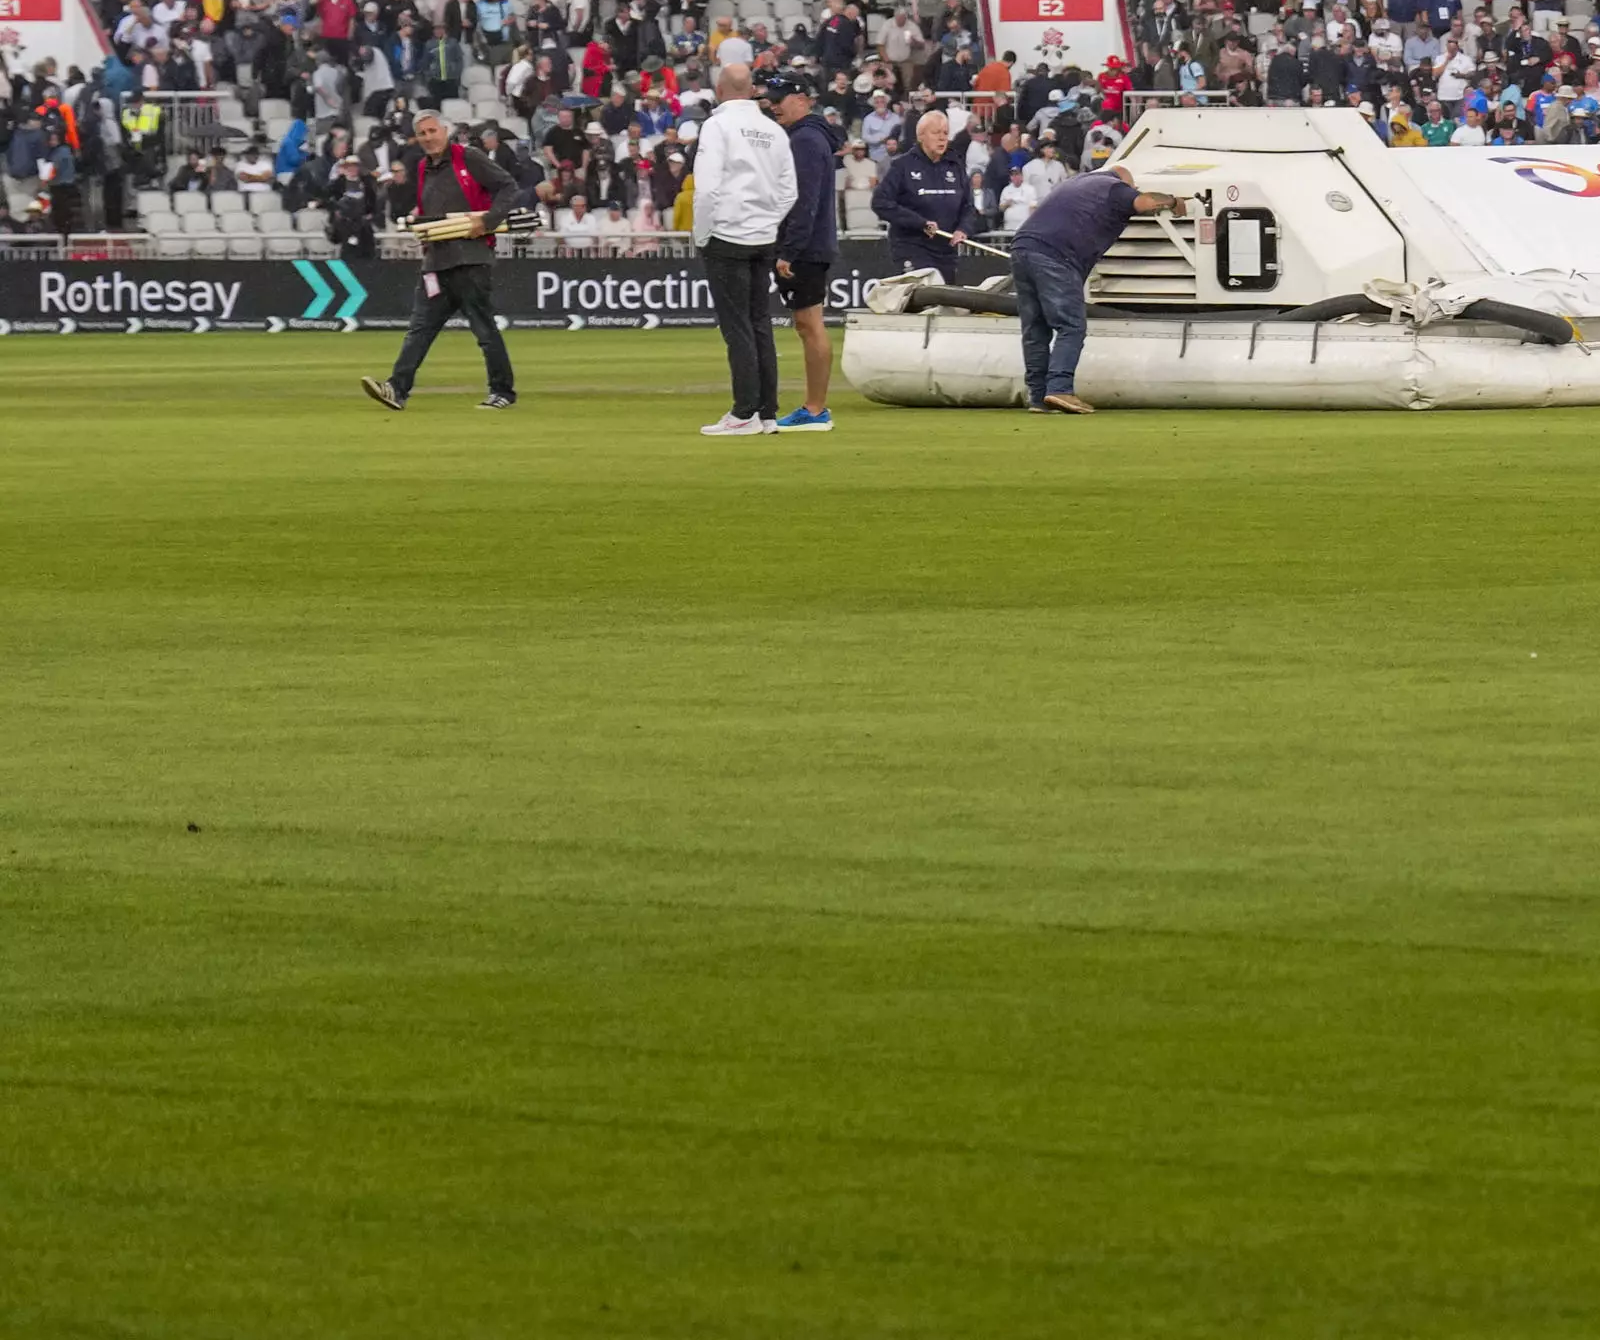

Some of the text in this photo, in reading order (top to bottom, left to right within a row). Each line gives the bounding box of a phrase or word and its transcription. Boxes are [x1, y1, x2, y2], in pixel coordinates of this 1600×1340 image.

[1038, 0, 1065, 16] E2
[40, 272, 241, 320] Rothesay
[537, 270, 715, 309] Protectin
